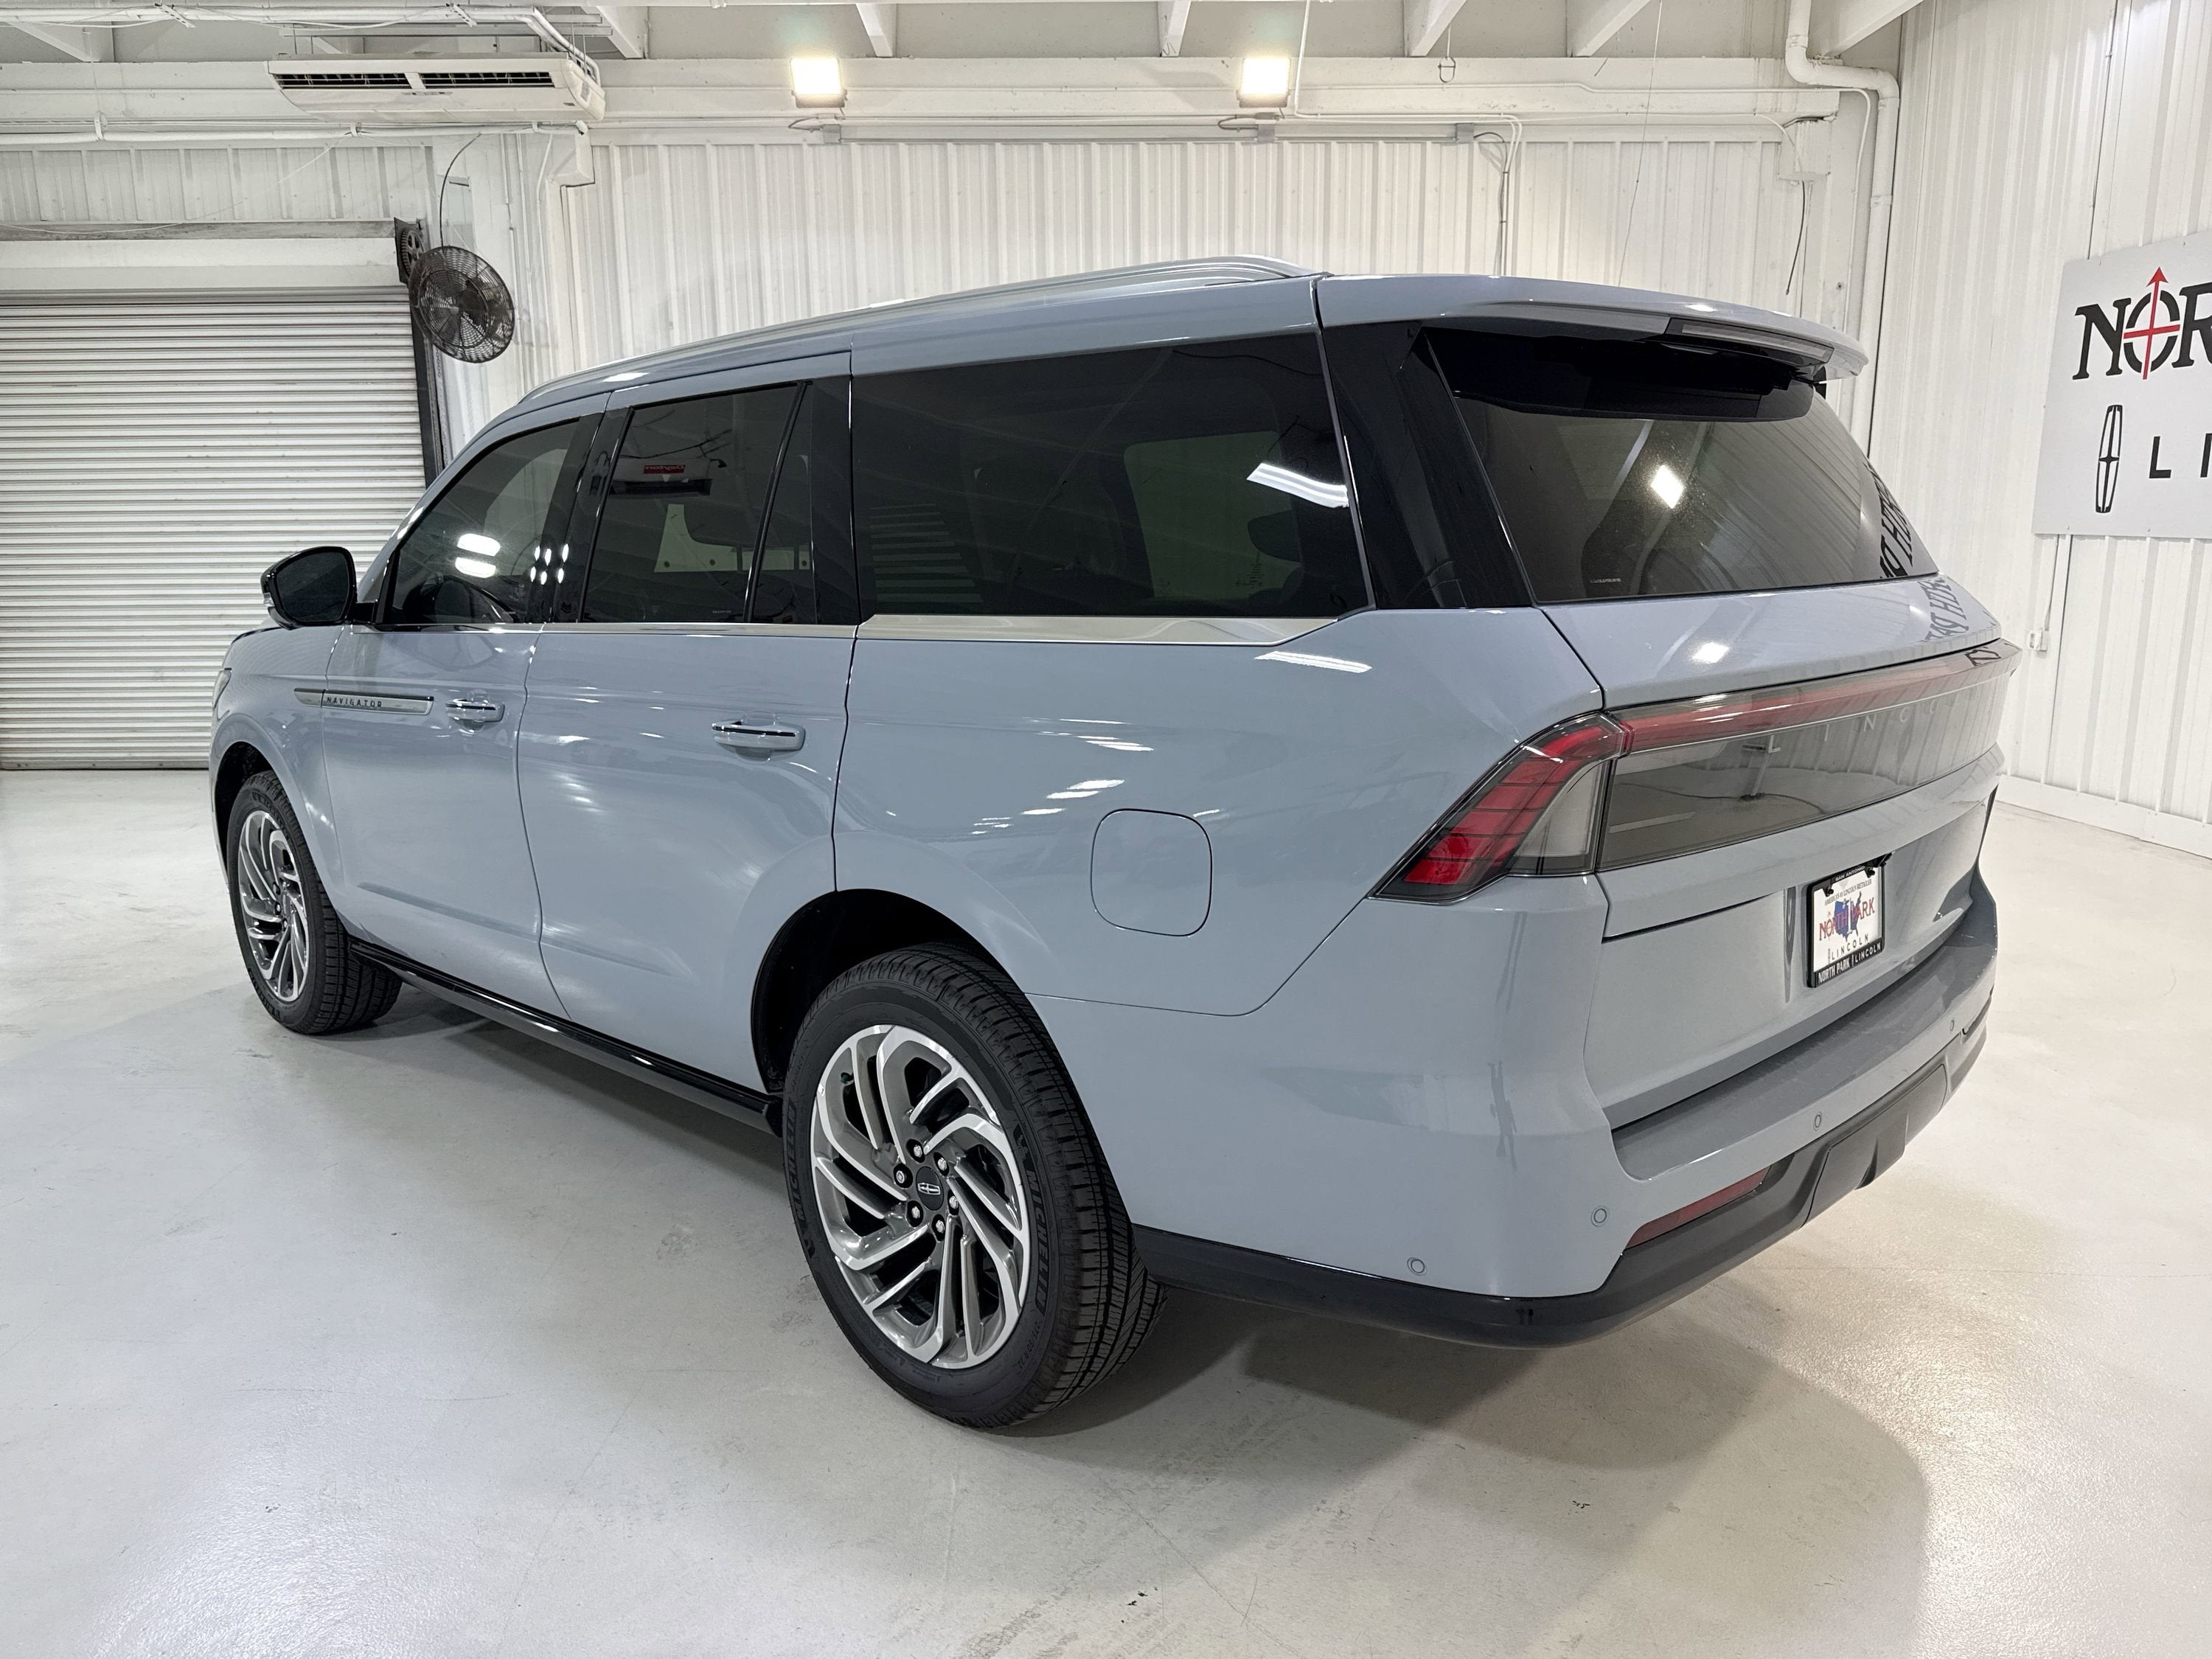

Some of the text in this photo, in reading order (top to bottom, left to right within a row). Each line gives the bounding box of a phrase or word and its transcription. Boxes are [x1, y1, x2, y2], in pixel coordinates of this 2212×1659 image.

[327, 697, 382, 708] NAVIGATOR
[1767, 686, 1980, 754] LINCOL
[1819, 897, 1875, 941] NORTH PARK
[1818, 942, 1881, 984] NORTH PARK LINCOLN
[1832, 933, 1869, 961] LINCOLN
[787, 1103, 806, 1221] MICHELIN
[1026, 1169, 1048, 1309] MICHELIN
